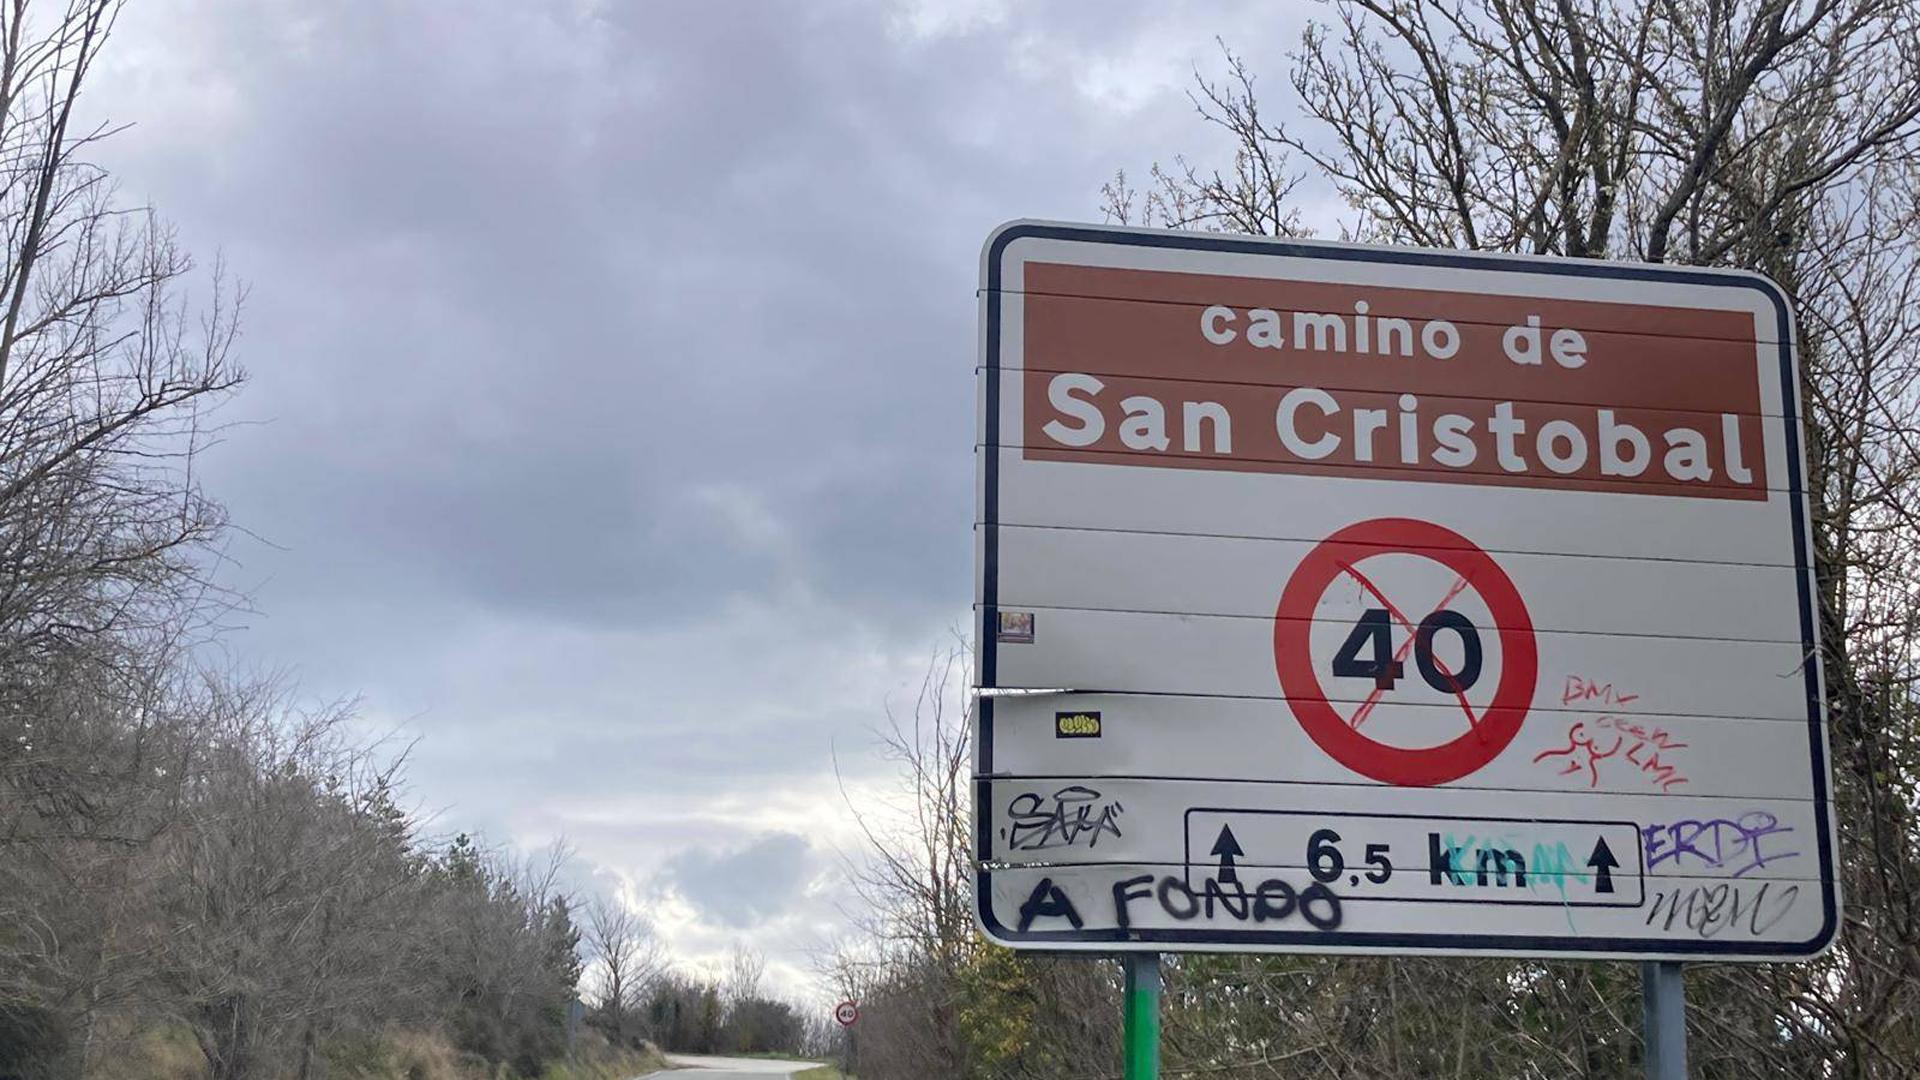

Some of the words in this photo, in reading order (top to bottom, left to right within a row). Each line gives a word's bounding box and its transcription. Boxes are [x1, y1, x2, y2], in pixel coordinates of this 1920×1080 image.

[1200, 300, 1462, 361] camino
[1502, 314, 1589, 369] de
[1042, 373, 1233, 455] San
[1276, 387, 1754, 486] Cristobal
[1331, 607, 1483, 694] 40
[1306, 828, 1393, 888] 6,5
[1427, 832, 1527, 888] km
[1017, 878, 1084, 933] A
[1112, 875, 1343, 938] FONDO
